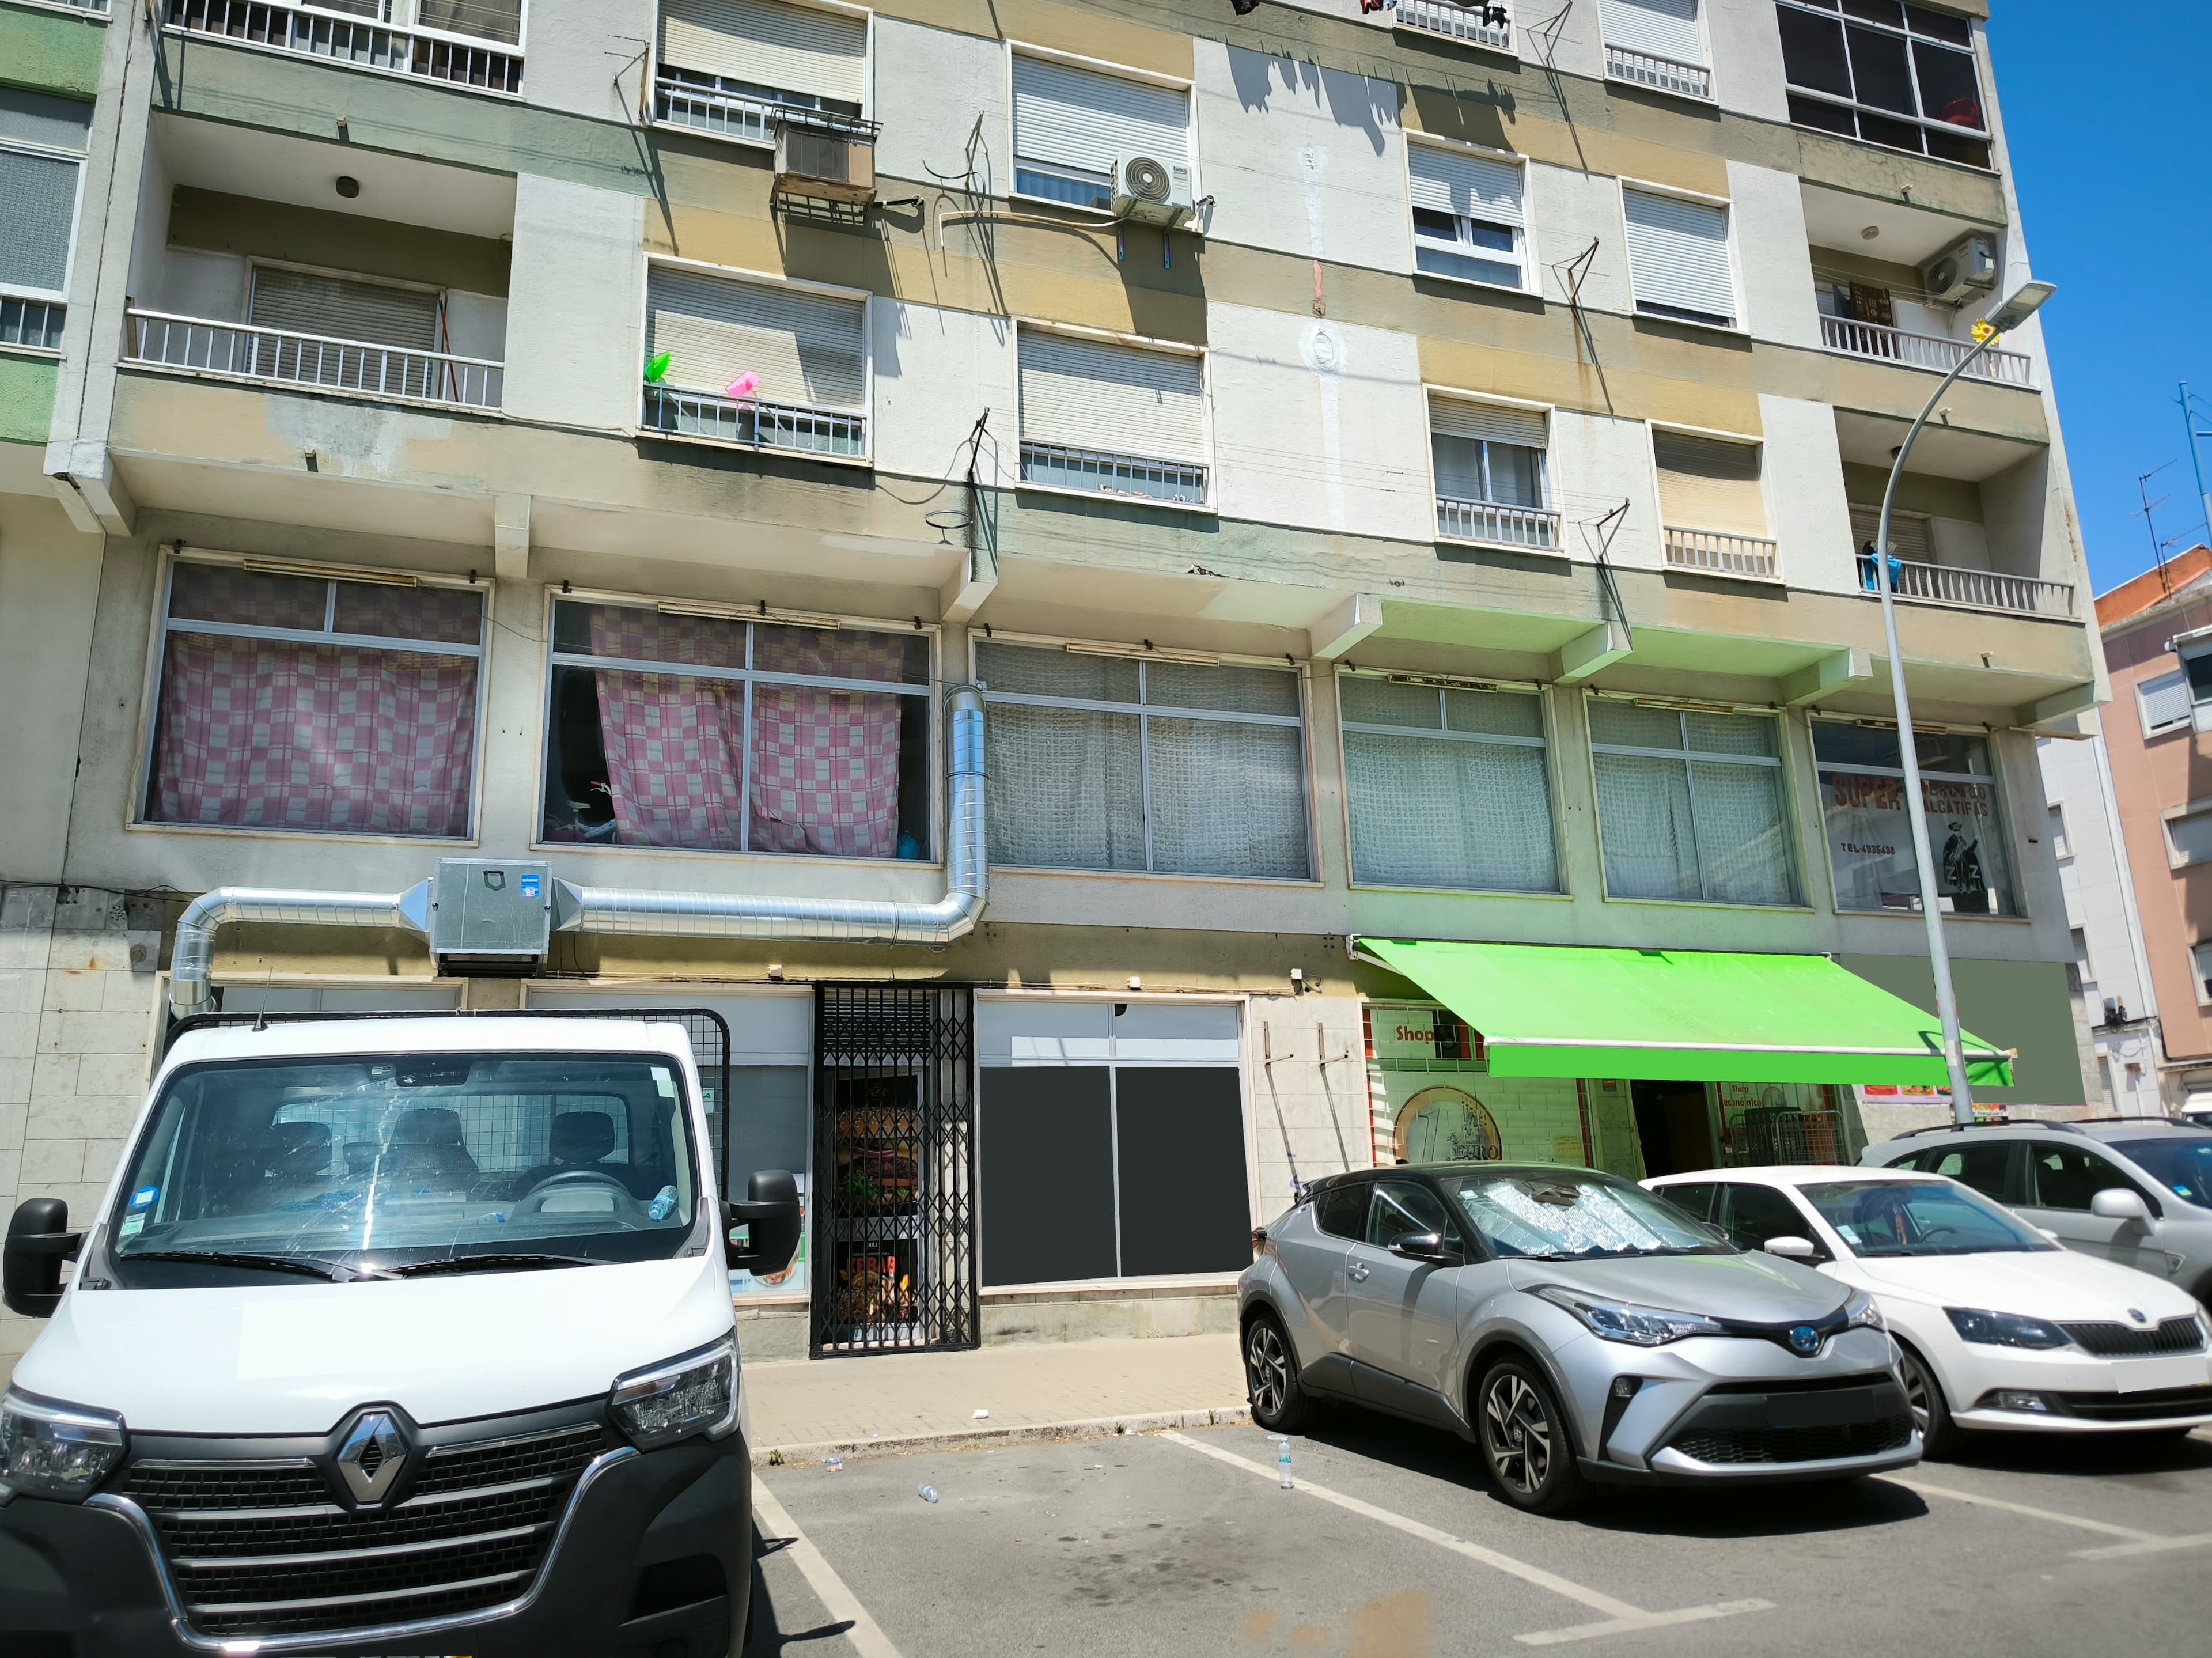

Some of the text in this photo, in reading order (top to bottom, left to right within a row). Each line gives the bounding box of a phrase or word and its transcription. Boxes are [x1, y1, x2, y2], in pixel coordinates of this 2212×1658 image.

[1832, 775, 1902, 811] SUPER
[1396, 1025, 1434, 1044] Shop
[1732, 1085, 1749, 1093] Shop
